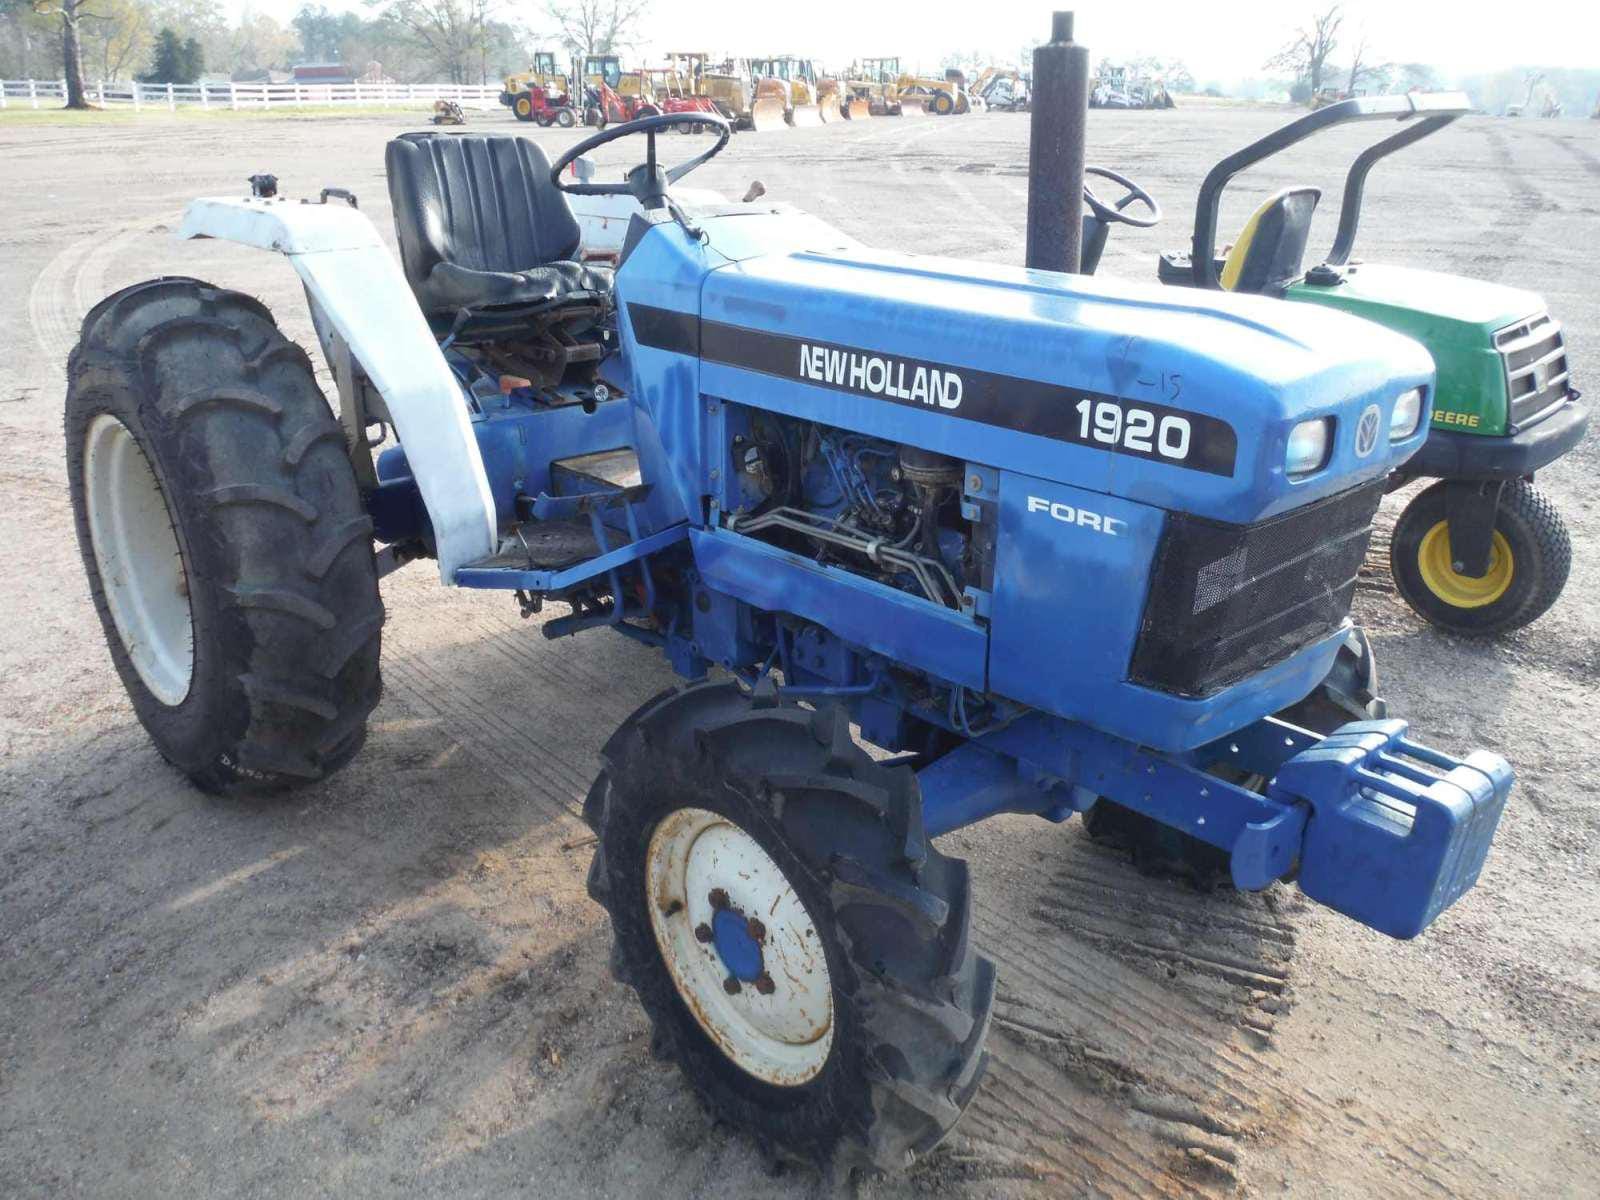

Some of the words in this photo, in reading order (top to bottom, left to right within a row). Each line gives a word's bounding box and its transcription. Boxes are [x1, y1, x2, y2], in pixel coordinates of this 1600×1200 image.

[800, 344, 847, 385] NEW
[850, 353, 963, 409] HOLLAND
[1076, 399, 1191, 459] 1920
[1431, 409, 1480, 427] EERE
